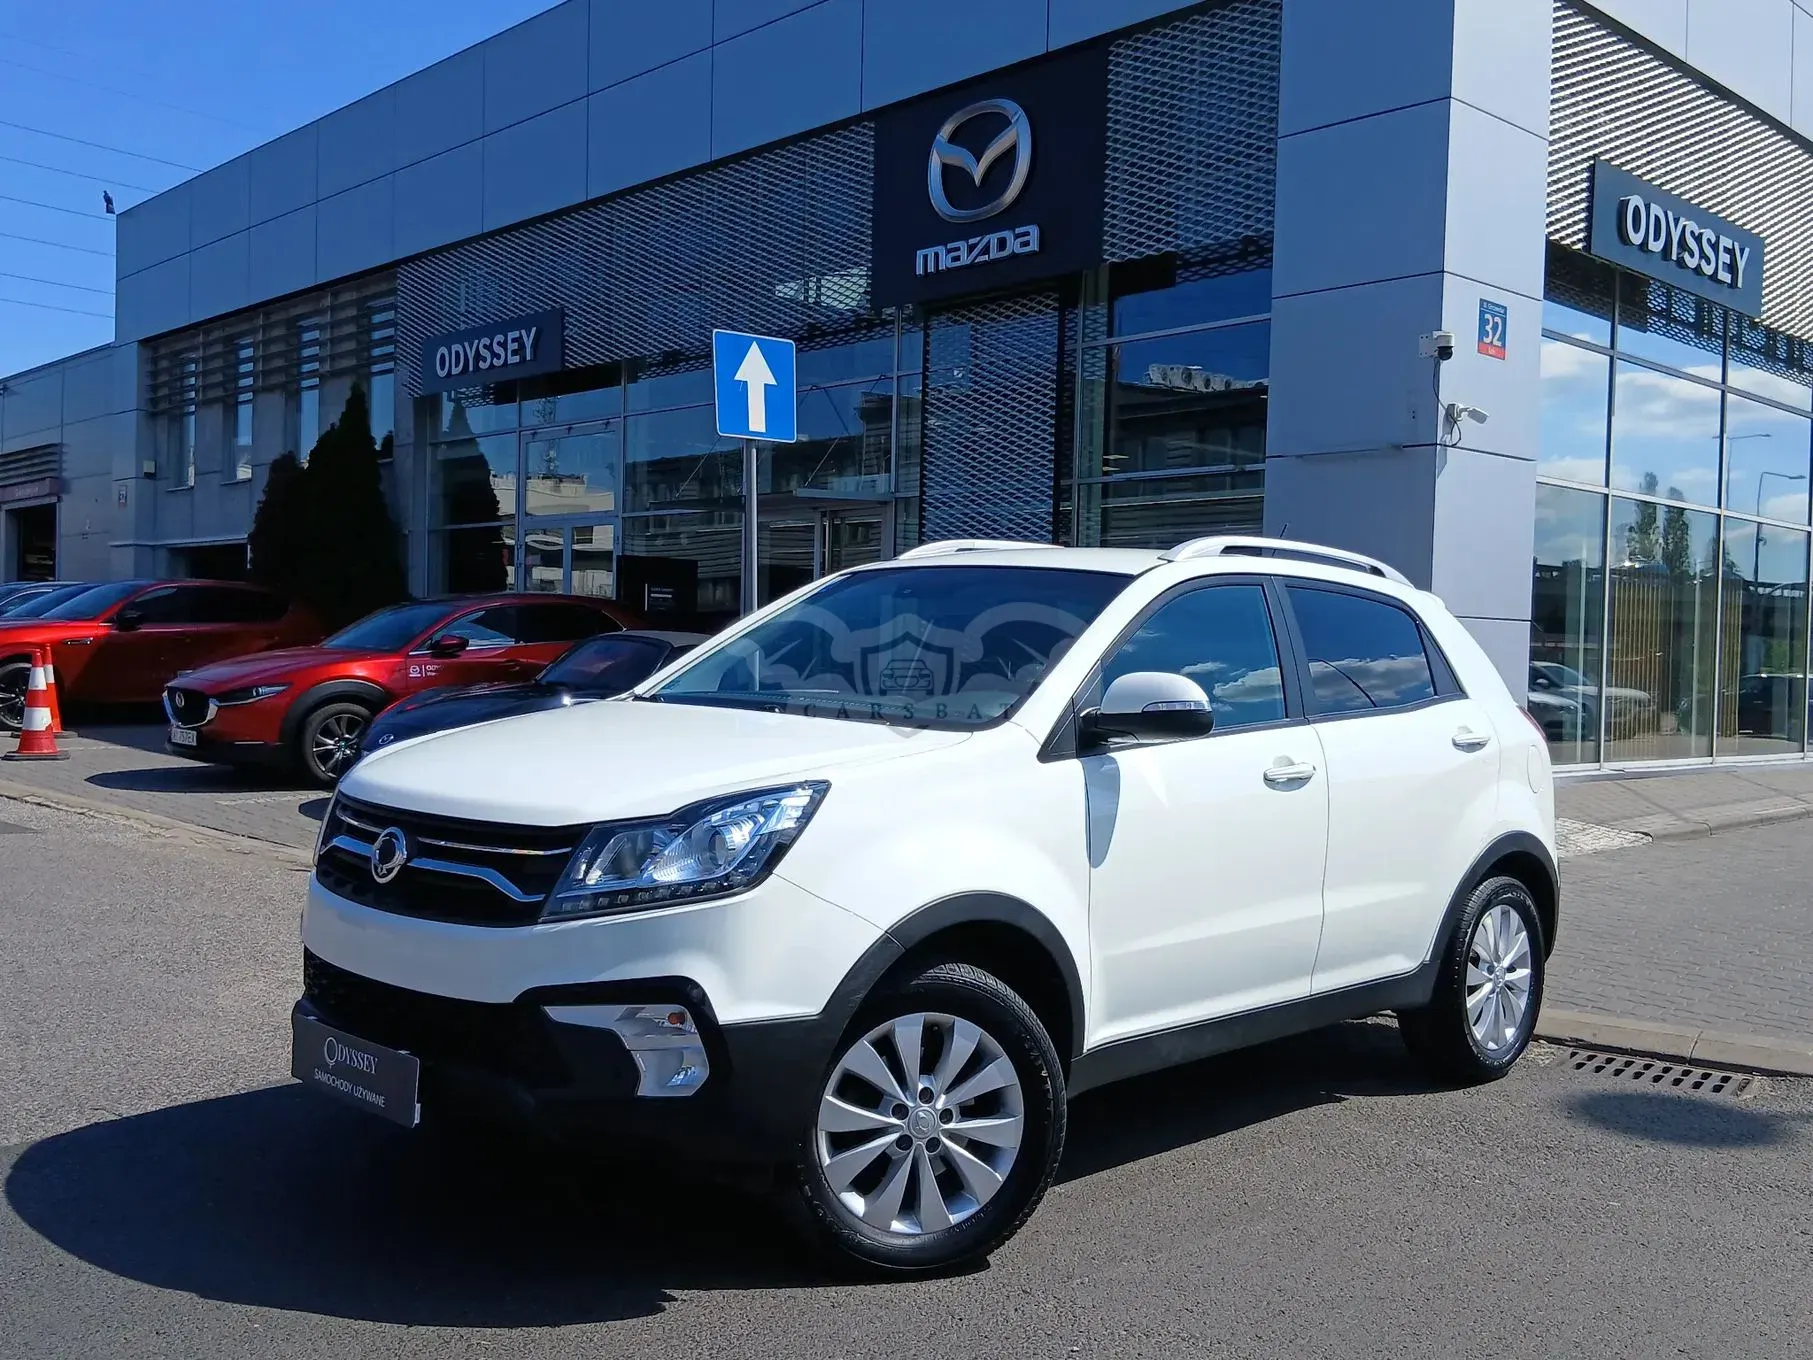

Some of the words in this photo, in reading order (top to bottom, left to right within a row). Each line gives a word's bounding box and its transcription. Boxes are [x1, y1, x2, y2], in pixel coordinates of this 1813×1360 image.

[915, 222, 1040, 276] mazda
[1622, 194, 1750, 289] ODYSSEY
[436, 327, 537, 378] ODYSSEY
[1483, 313, 1502, 347] 32
[324, 1036, 378, 1075] ODYSSEY
[314, 1067, 353, 1095] SAMOCHODY
